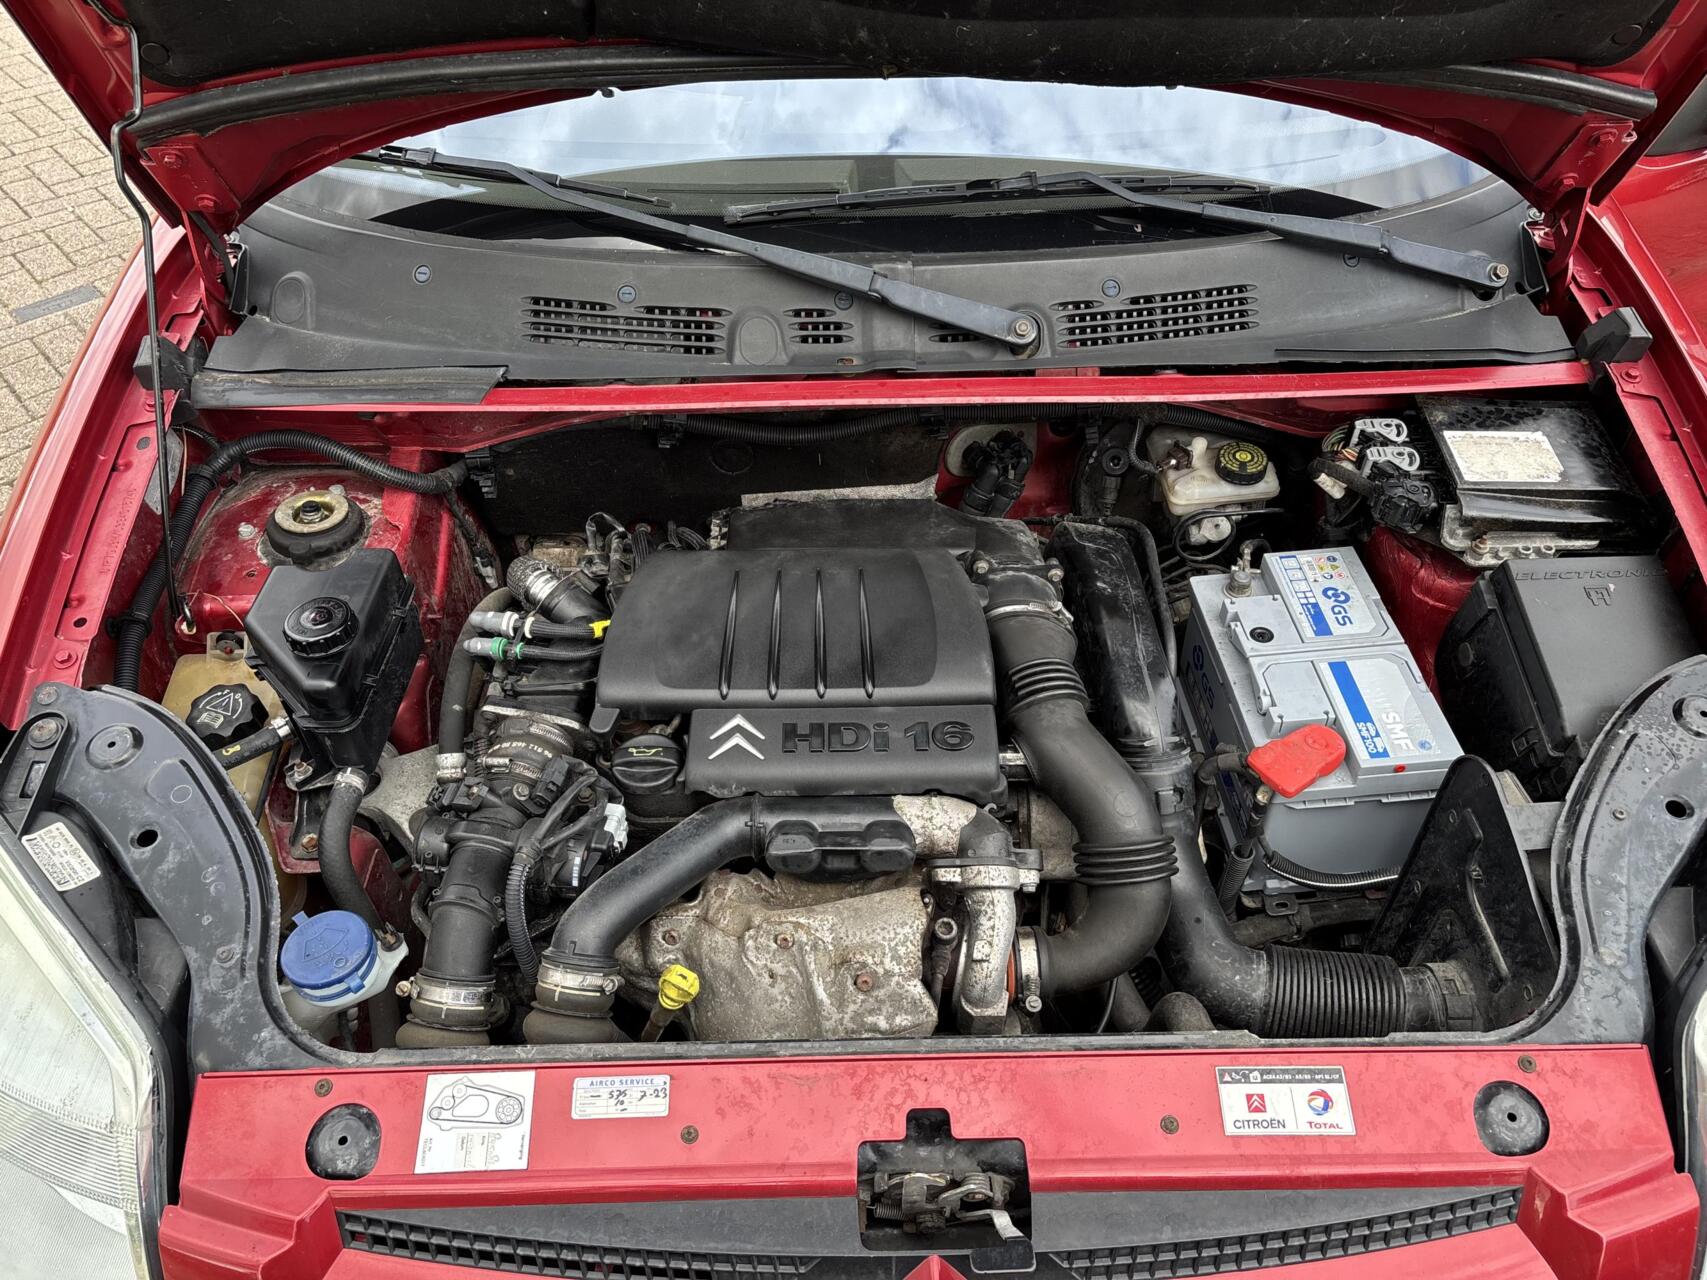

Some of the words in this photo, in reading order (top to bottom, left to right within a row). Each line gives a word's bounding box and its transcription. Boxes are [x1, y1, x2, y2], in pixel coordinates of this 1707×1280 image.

[1330, 604, 1353, 628] GS
[782, 721, 890, 753] HDi
[904, 720, 975, 752] 16
[1356, 722, 1377, 753] SMF100
[1382, 711, 1414, 750] SMF
[1233, 1117, 1286, 1129] CITROËN
